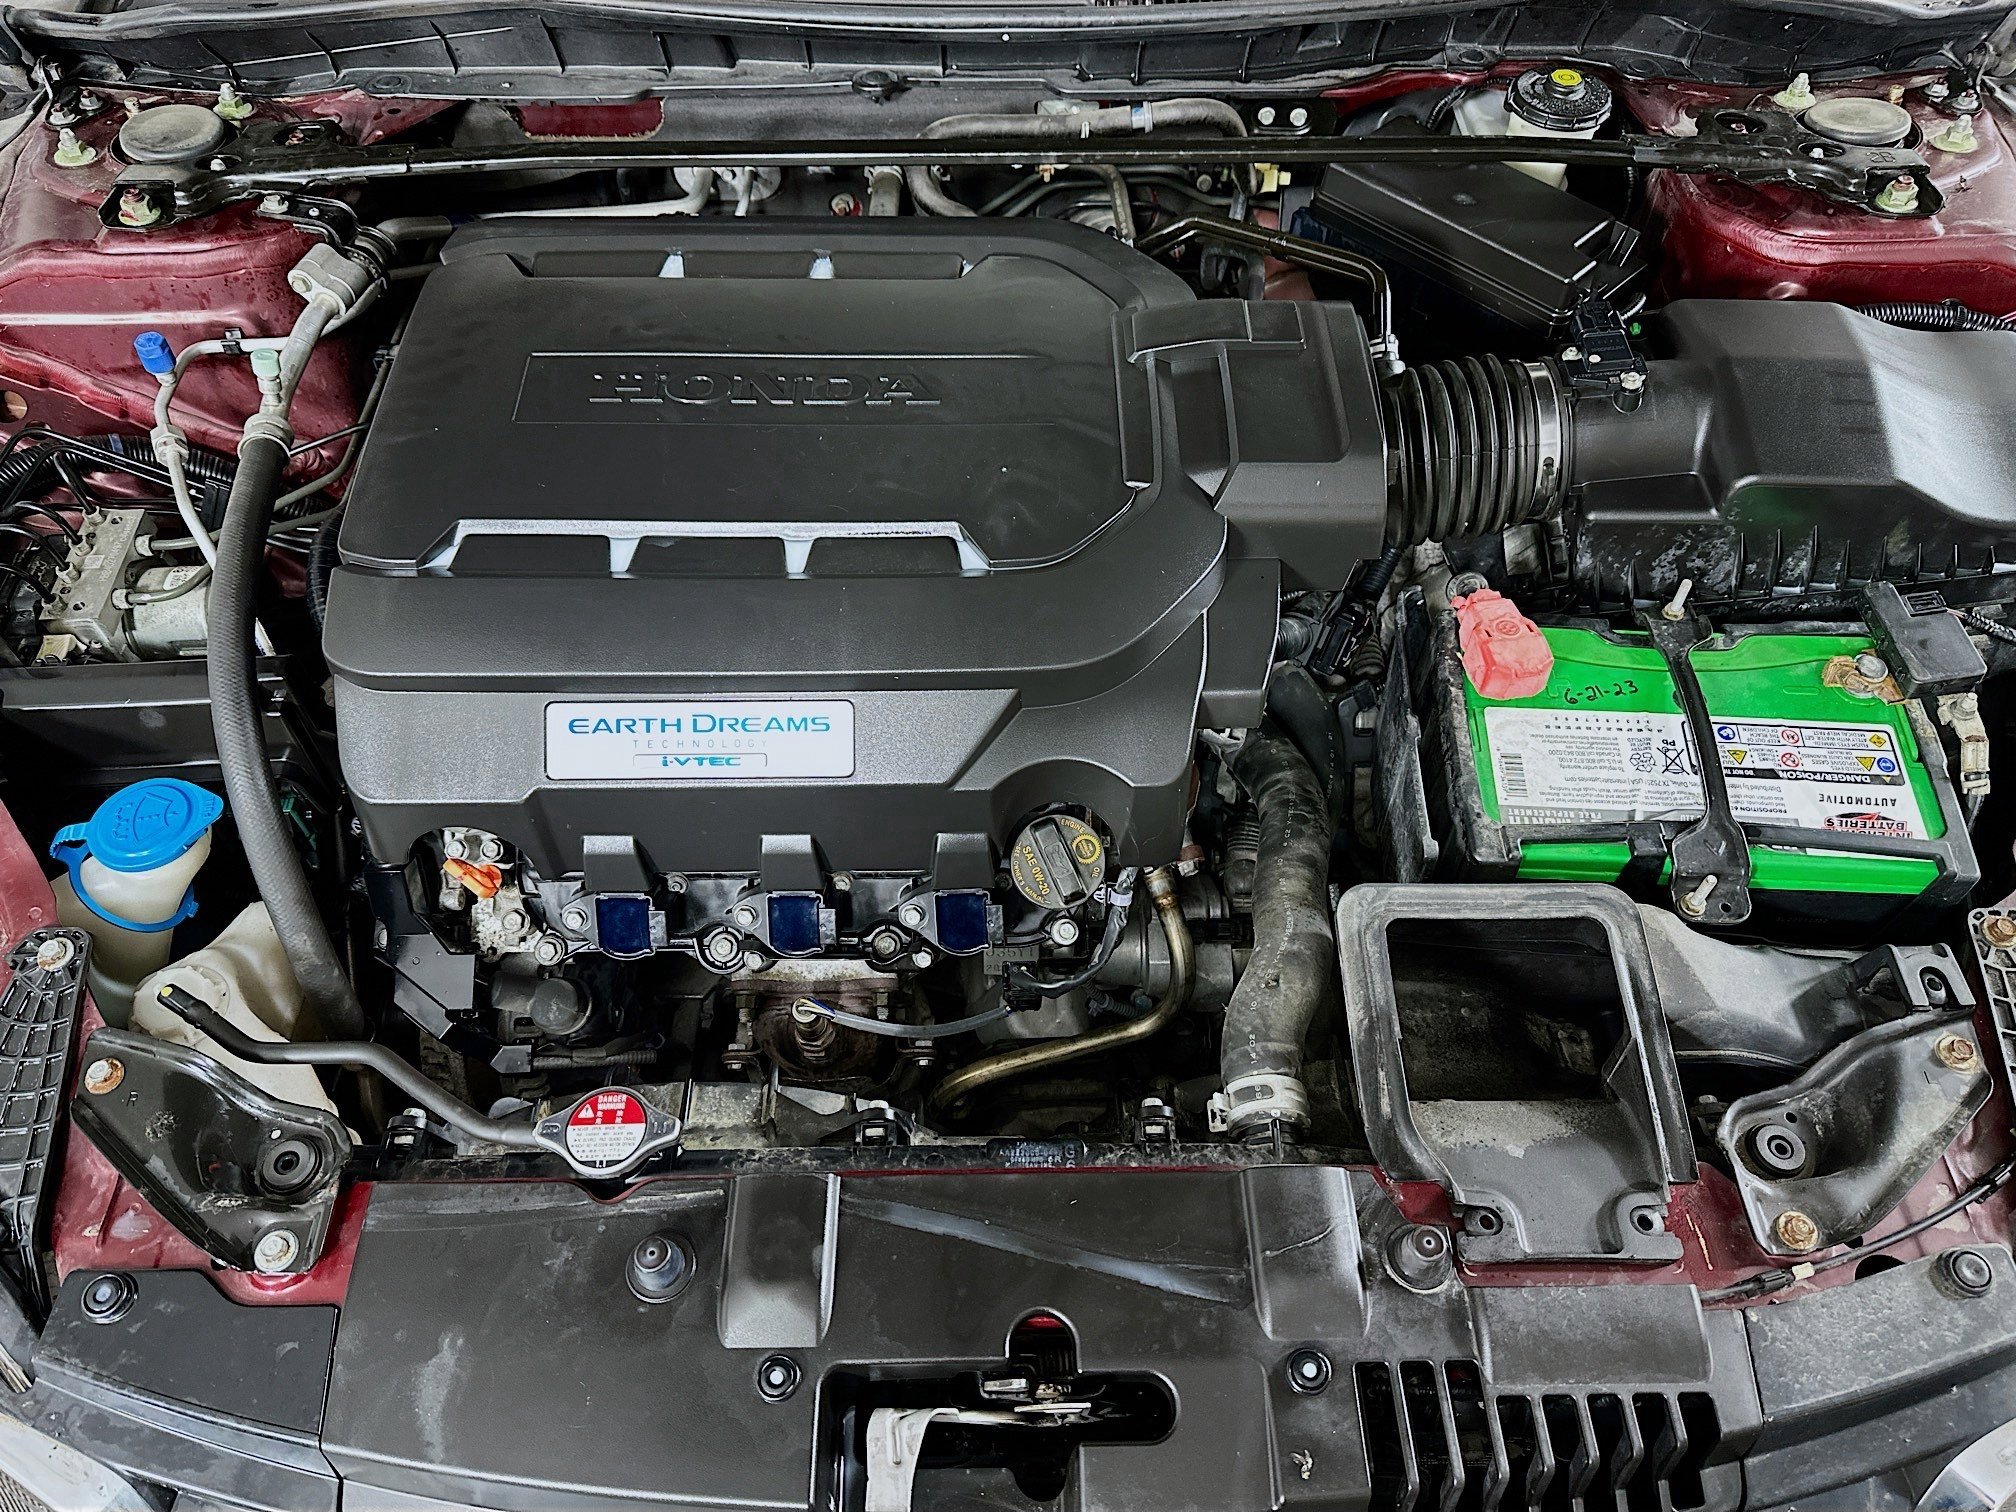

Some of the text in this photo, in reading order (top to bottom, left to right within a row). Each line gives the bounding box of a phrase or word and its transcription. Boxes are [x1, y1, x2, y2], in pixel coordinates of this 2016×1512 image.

[589, 372, 941, 405] HONDA
[1563, 679, 1639, 705] 6-21-23
[568, 714, 831, 735] EARTH DREAMS
[632, 738, 768, 749] TECHNOLOGY
[661, 755, 742, 768] i-VTEC
[1778, 770, 1870, 783] DANGER/POISON
[1818, 793, 1897, 806] AUTOMOTIVE
[1508, 808, 1575, 818] REPLACEMENT
[1060, 819, 1086, 834] ENGINE
[1825, 818, 1906, 831] BATTERIES
[1022, 846, 1050, 896] SAE 0W-20
[1092, 866, 1101, 878] OIL
[1250, 1052, 1258, 1065] 14
[126, 1090, 139, 1107] R
[598, 1094, 627, 1103] DANGER
